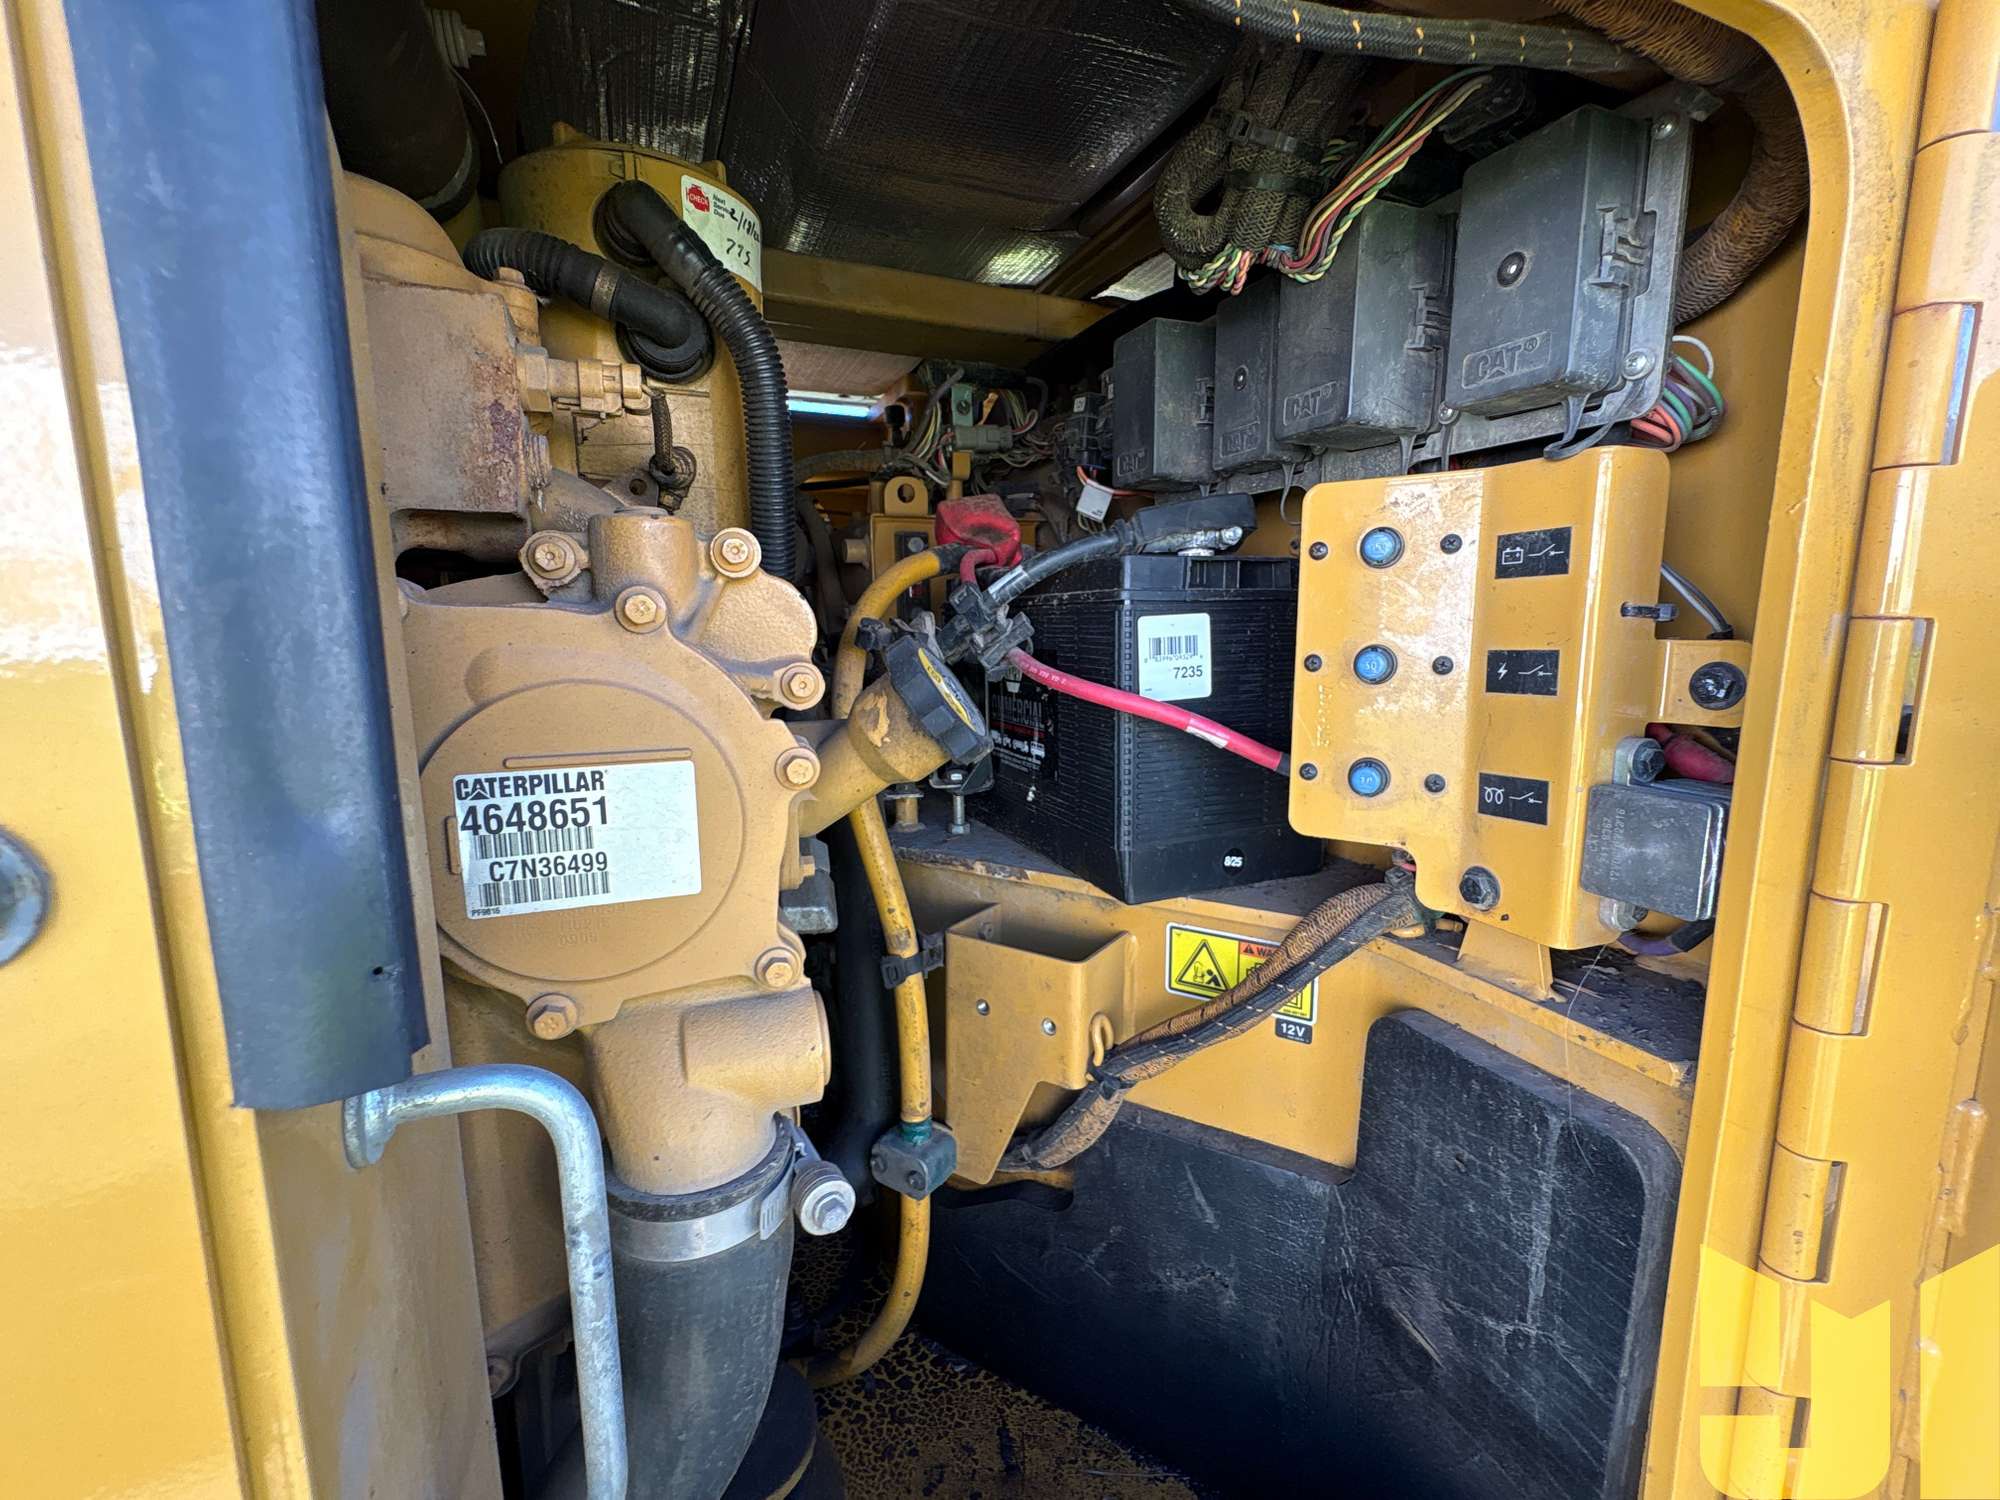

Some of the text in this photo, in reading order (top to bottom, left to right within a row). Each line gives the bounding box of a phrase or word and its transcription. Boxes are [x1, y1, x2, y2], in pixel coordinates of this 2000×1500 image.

[1172, 664, 1204, 679] 7235
[455, 770, 605, 801] CATERPILLAR
[461, 795, 608, 836] 4648651
[488, 851, 608, 882] C7N36499
[1280, 1022, 1306, 1037] 12V
